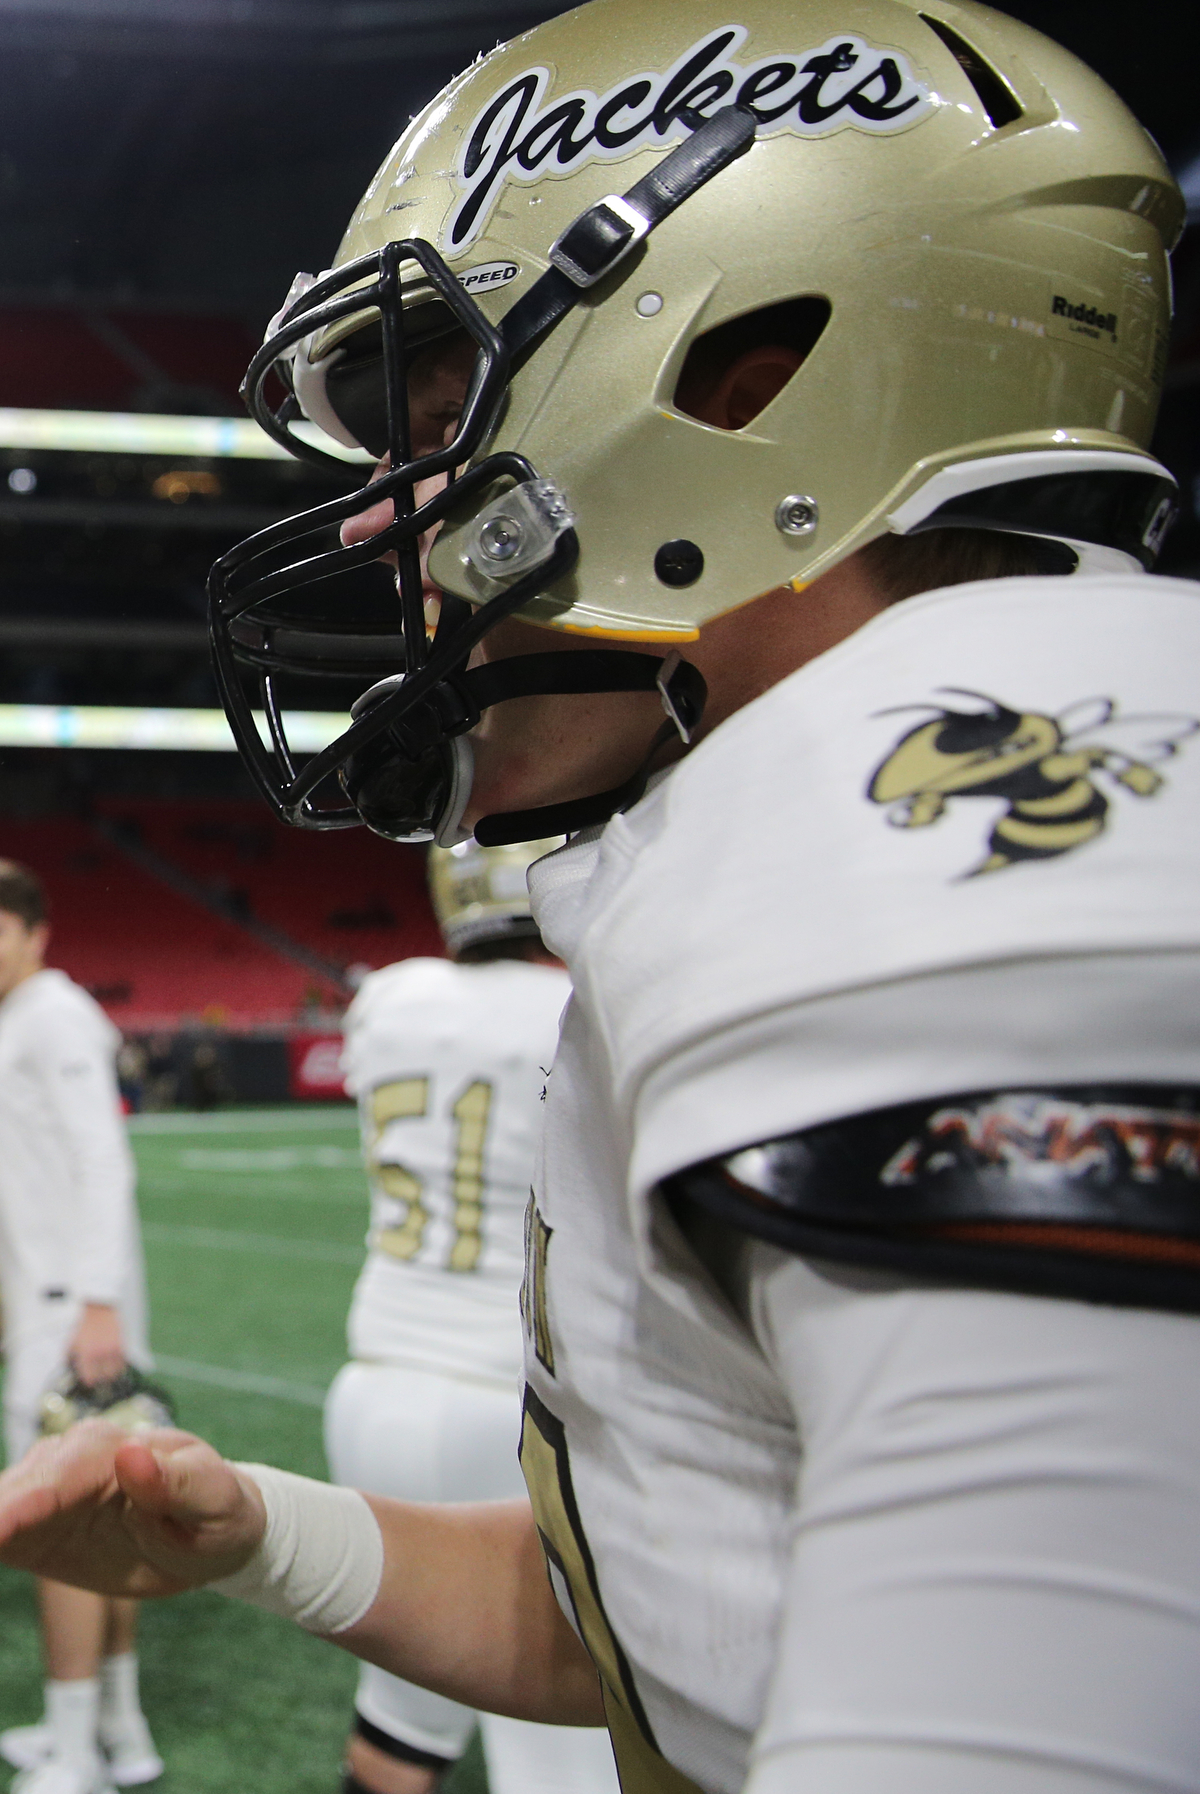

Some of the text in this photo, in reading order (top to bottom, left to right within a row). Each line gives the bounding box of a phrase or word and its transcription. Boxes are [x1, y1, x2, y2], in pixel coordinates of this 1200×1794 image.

[452, 30, 920, 244] Jackets
[1052, 295, 1118, 333] Riddell
[368, 1075, 493, 1273] 51
